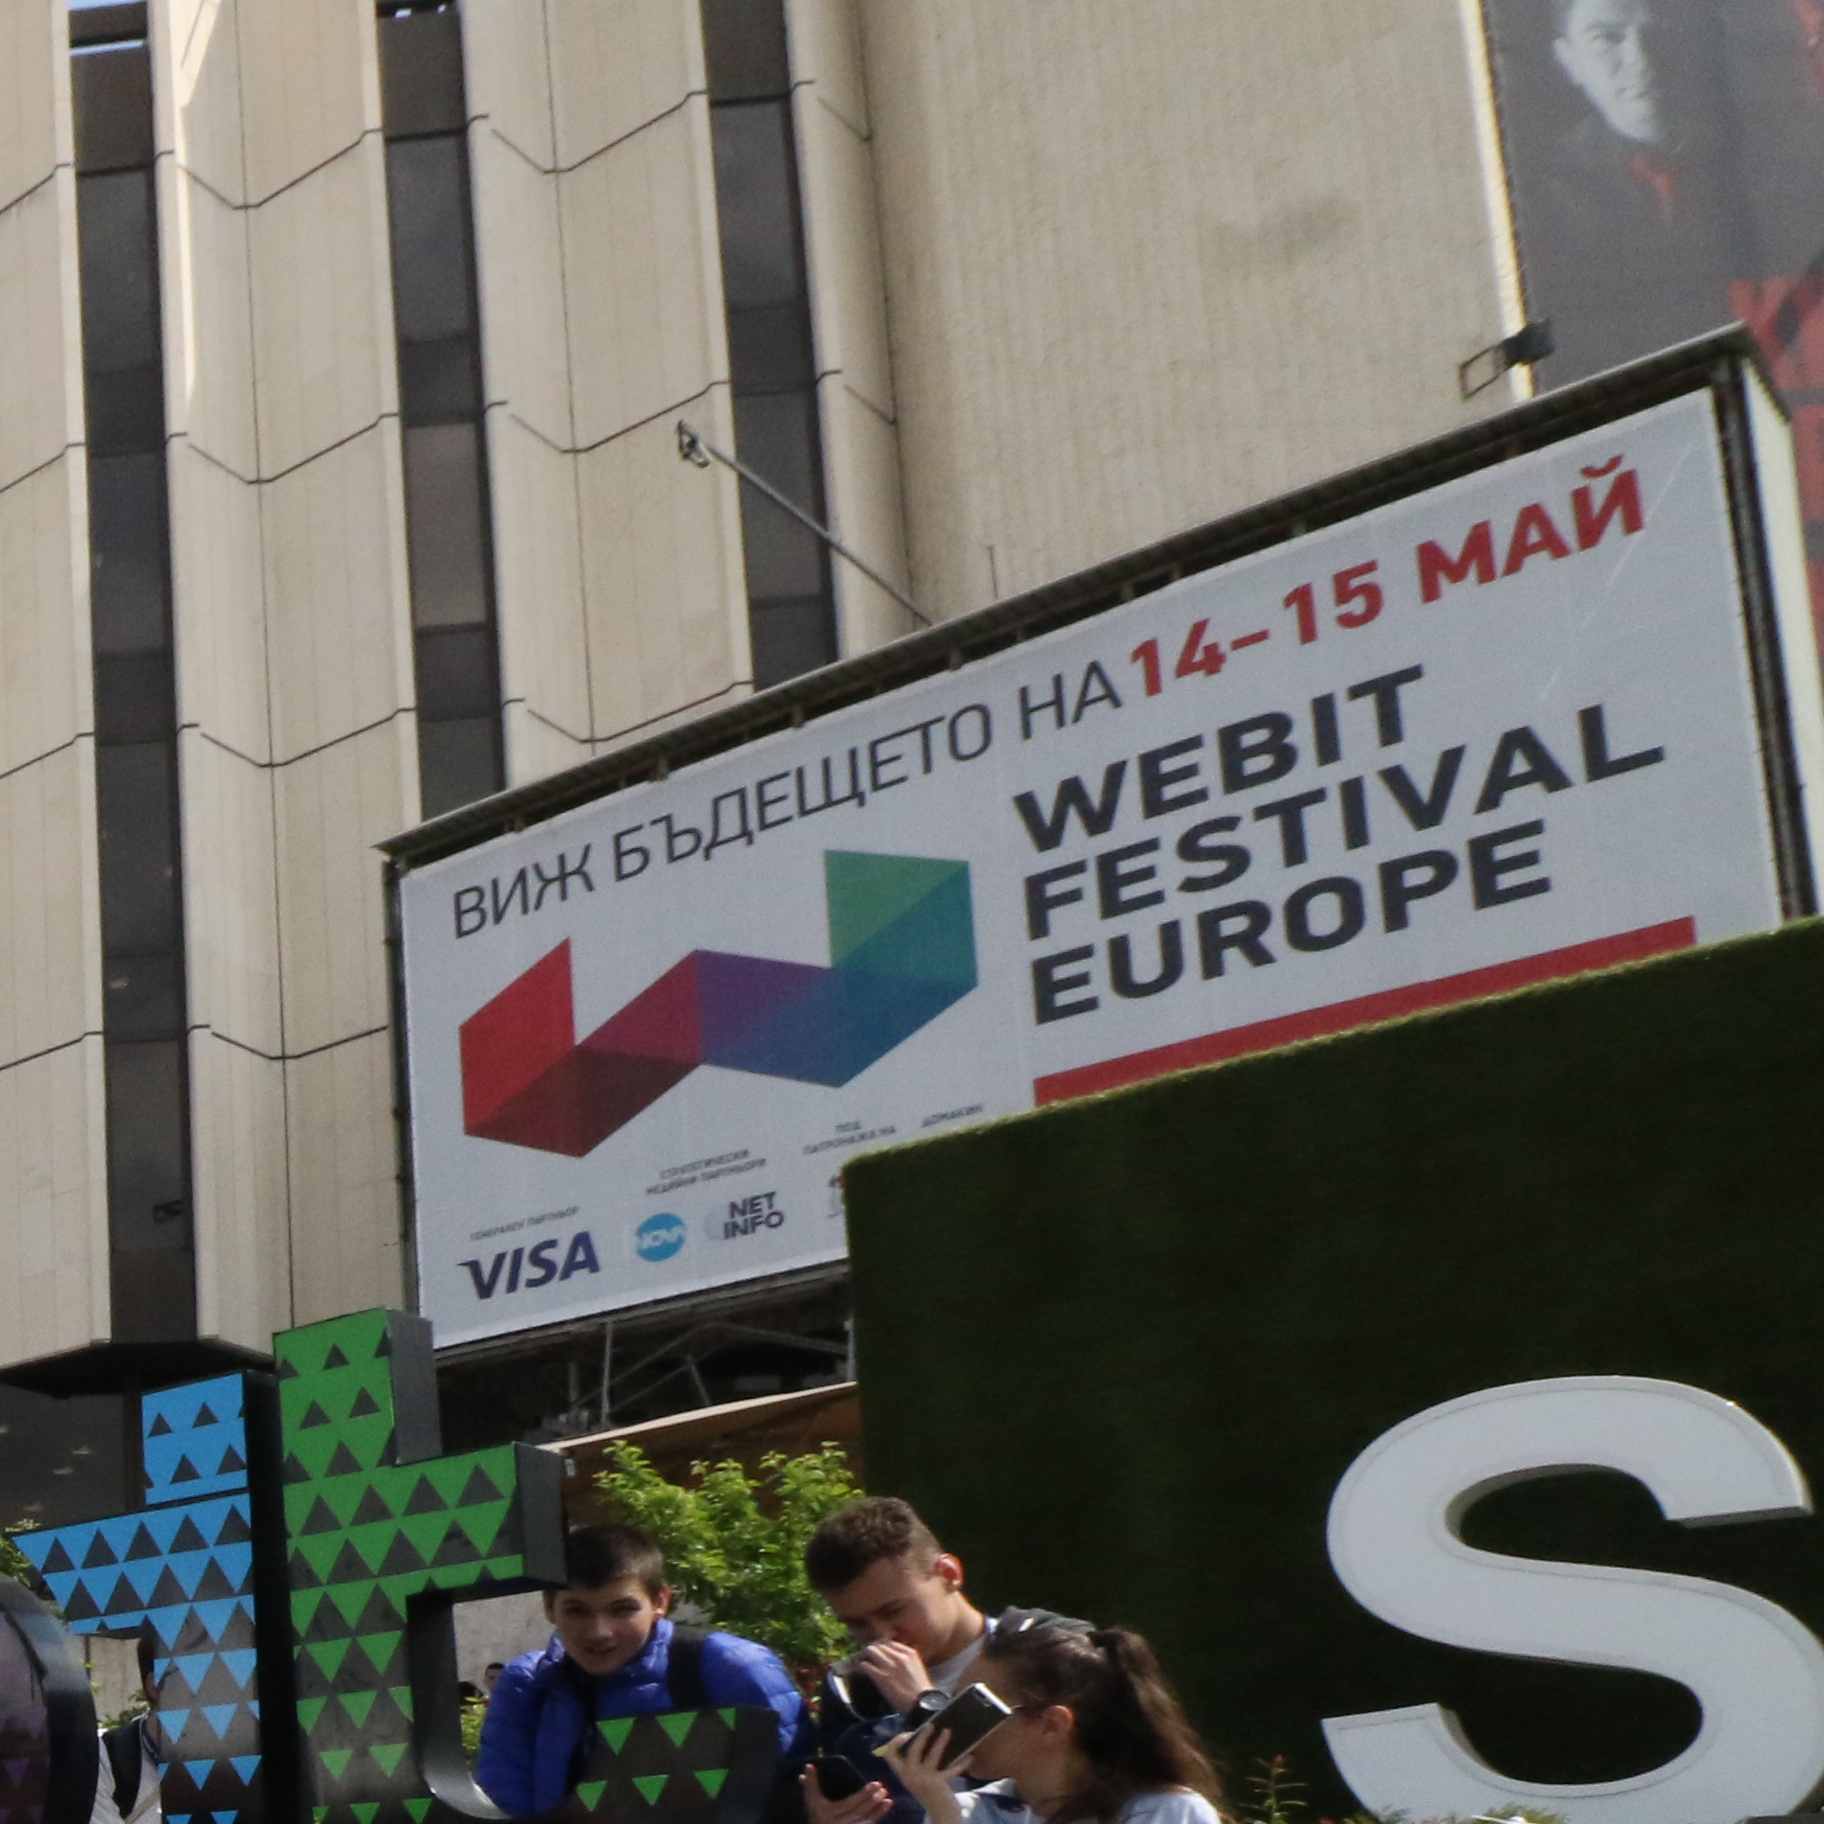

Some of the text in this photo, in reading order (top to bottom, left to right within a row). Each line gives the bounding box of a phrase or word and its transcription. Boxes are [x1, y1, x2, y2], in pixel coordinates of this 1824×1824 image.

[453, 845, 595, 939] ВИЖ
[613, 703, 993, 883] БЪДЕЩЕТО
[1019, 661, 1125, 740] НА
[1416, 455, 1647, 604] МАЙ
[1013, 664, 1425, 853] WEBIT
[1024, 704, 1666, 941] FESTIVAL
[1032, 820, 1552, 1025] EUROPE
[458, 1230, 601, 1299] VISA
[723, 1210, 786, 1240] INFO
[729, 1191, 777, 1220] NET
